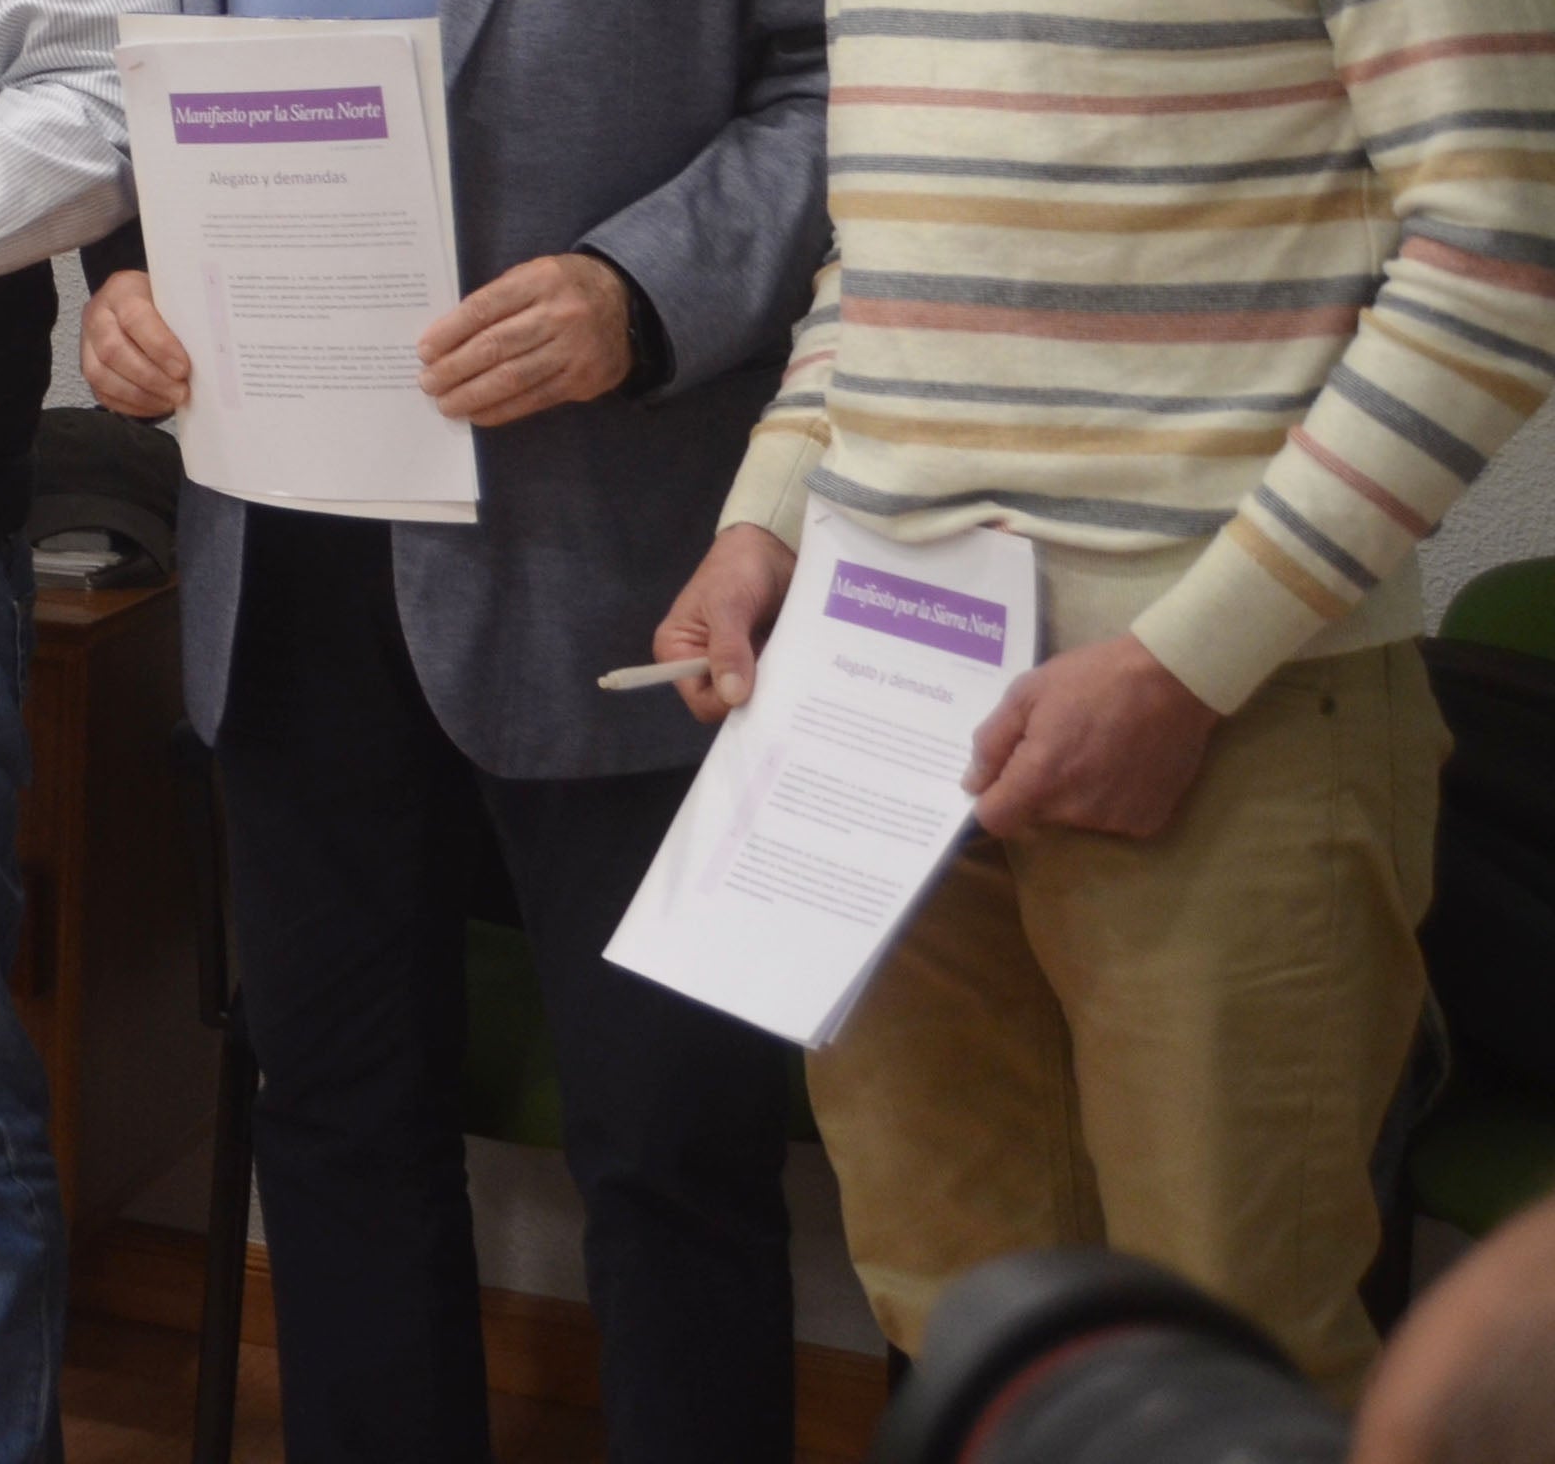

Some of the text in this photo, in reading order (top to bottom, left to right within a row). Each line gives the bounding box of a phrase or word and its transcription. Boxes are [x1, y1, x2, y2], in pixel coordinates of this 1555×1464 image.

[175, 102, 381, 128] Manifiesto por la Sierra Norte
[209, 171, 258, 189] Alegato
[273, 170, 347, 186] demandas
